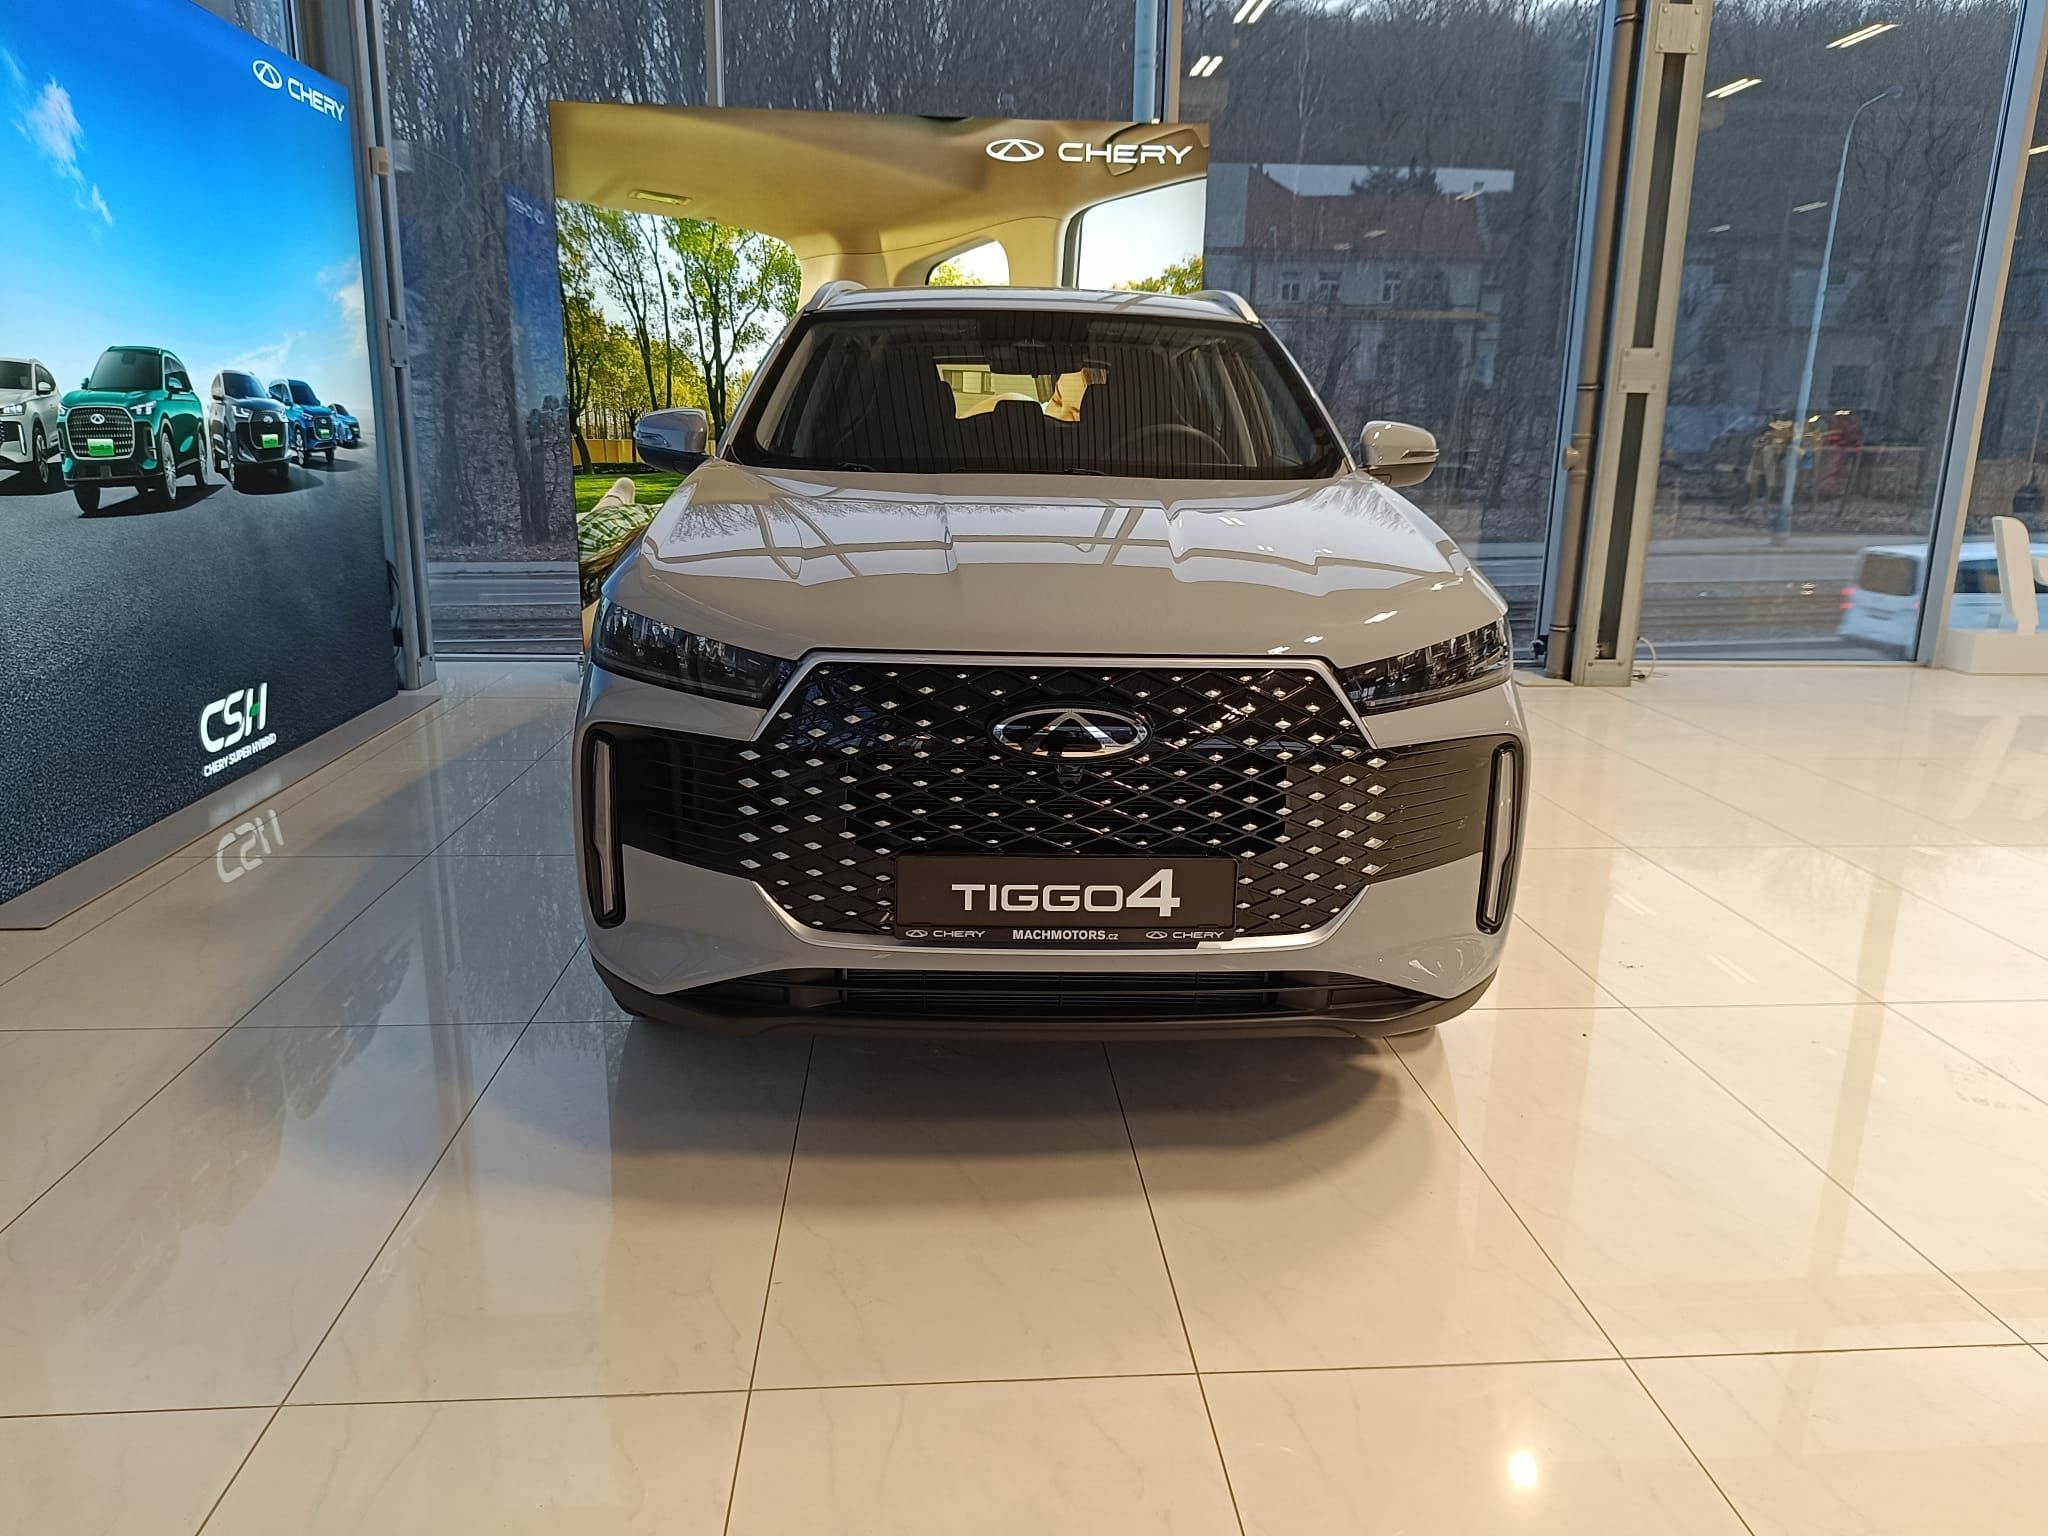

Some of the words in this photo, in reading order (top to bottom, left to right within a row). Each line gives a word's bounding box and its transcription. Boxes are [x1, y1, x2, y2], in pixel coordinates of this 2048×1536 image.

[287, 77, 344, 122] CHERY
[1058, 142, 1192, 165] CHERY
[200, 682, 267, 753] CSH
[203, 756, 228, 777] CHERY
[229, 745, 252, 765] SUPER
[252, 732, 277, 754] HYBRID
[932, 930, 986, 939] CHERY
[1012, 929, 1119, 941] MACHMOTORS.cz
[1172, 931, 1224, 940] CHERY
